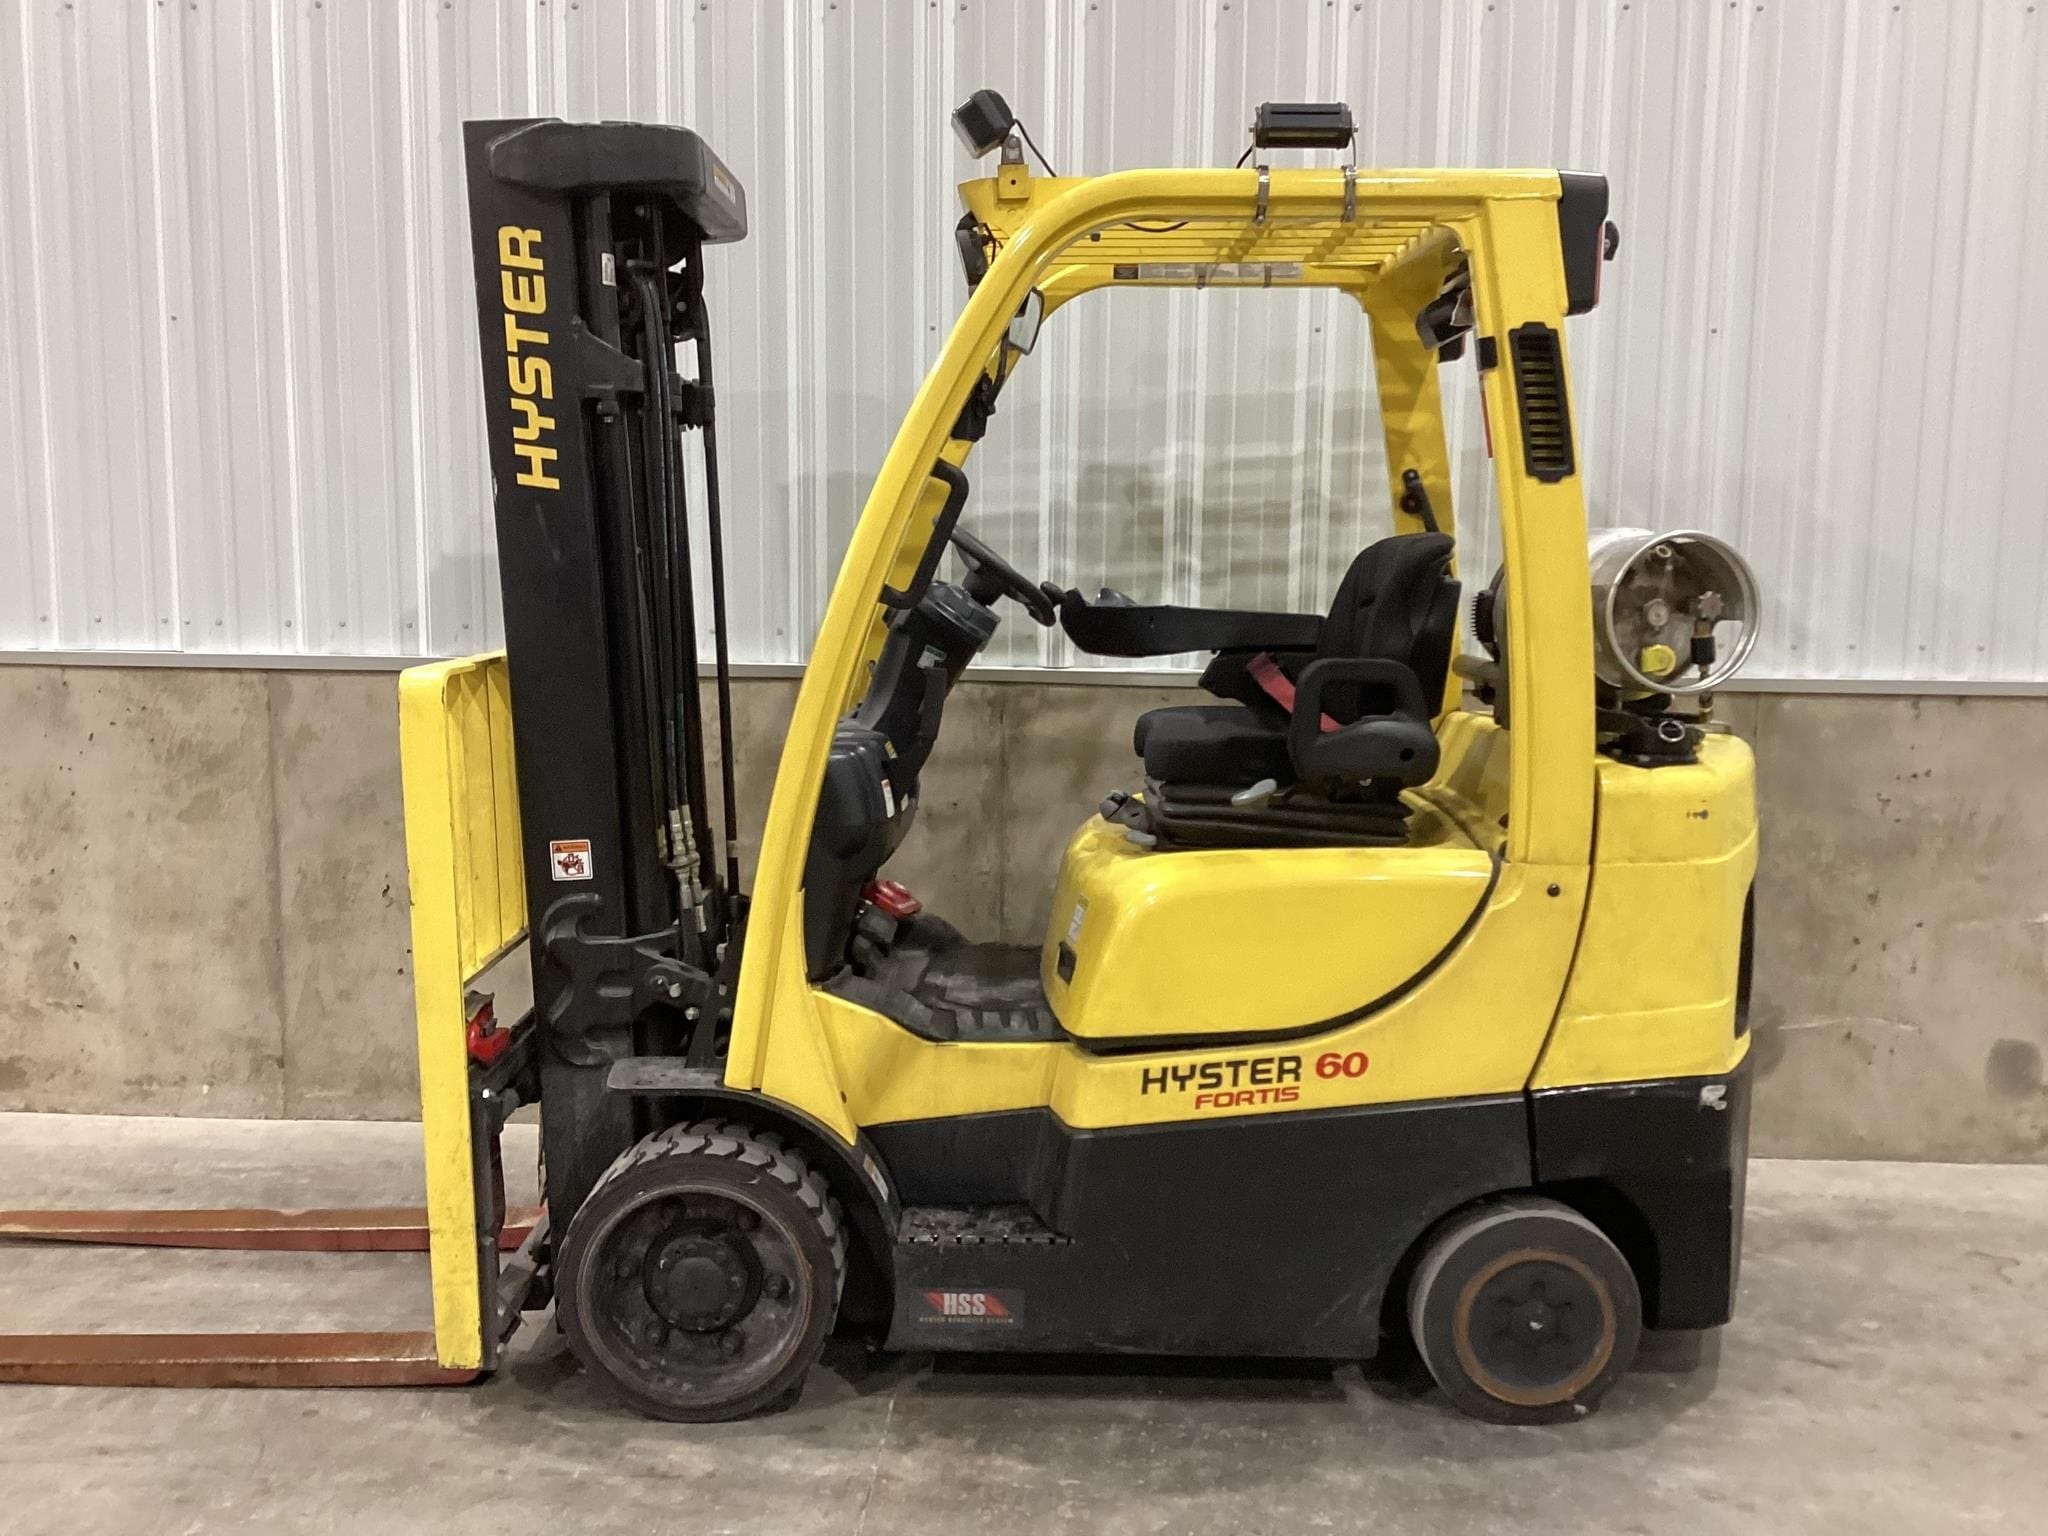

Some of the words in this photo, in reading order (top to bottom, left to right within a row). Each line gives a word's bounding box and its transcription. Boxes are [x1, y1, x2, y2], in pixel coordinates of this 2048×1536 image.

[497, 224, 561, 491] HYSTER
[1141, 1055, 1303, 1095] HYSTER
[1315, 1052, 1370, 1079] 60
[1194, 1086, 1300, 1110] FORTIS
[942, 1292, 987, 1316] HSS
